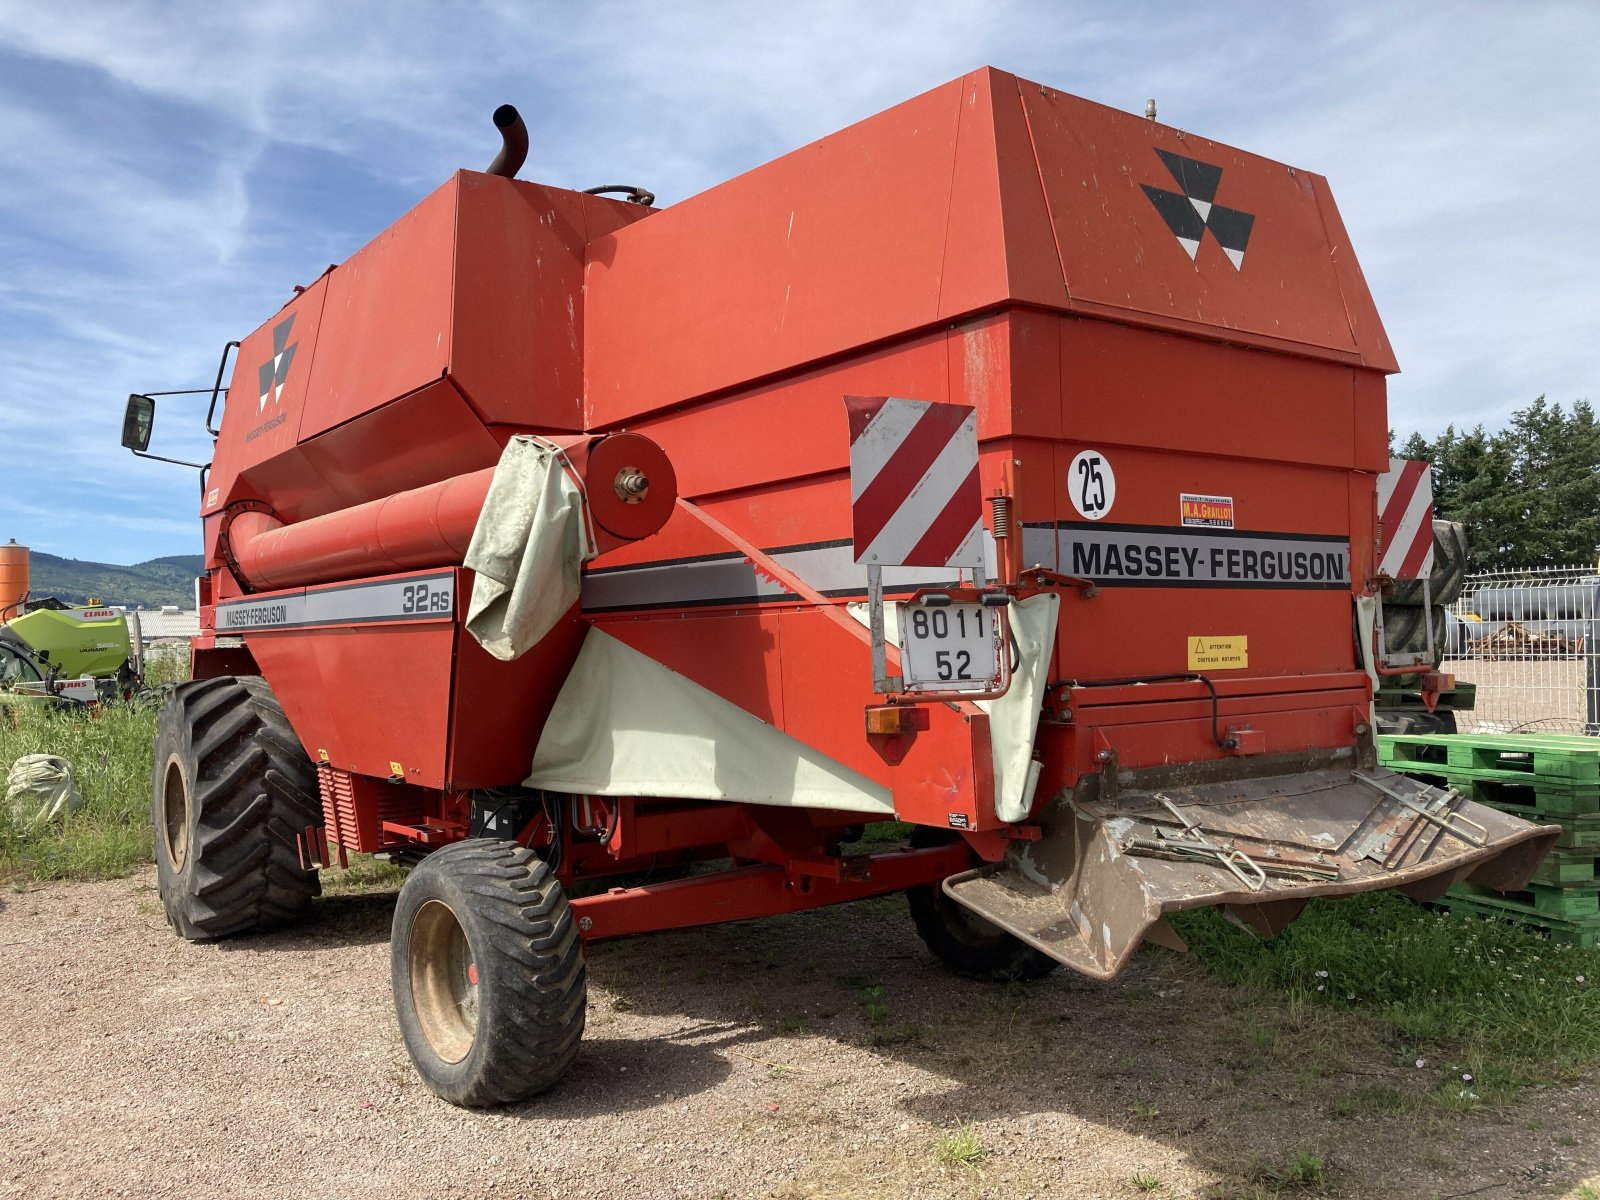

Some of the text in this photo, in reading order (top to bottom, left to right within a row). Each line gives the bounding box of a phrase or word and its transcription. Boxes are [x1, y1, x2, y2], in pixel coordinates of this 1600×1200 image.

[1079, 457, 1105, 512] 25
[1073, 542, 1343, 580] MASSEY-FERGUSON
[402, 584, 449, 613] 32 RS
[226, 605, 286, 626] MASSEY-FERGUSON
[912, 608, 984, 639] 8011
[935, 650, 971, 681] 52
